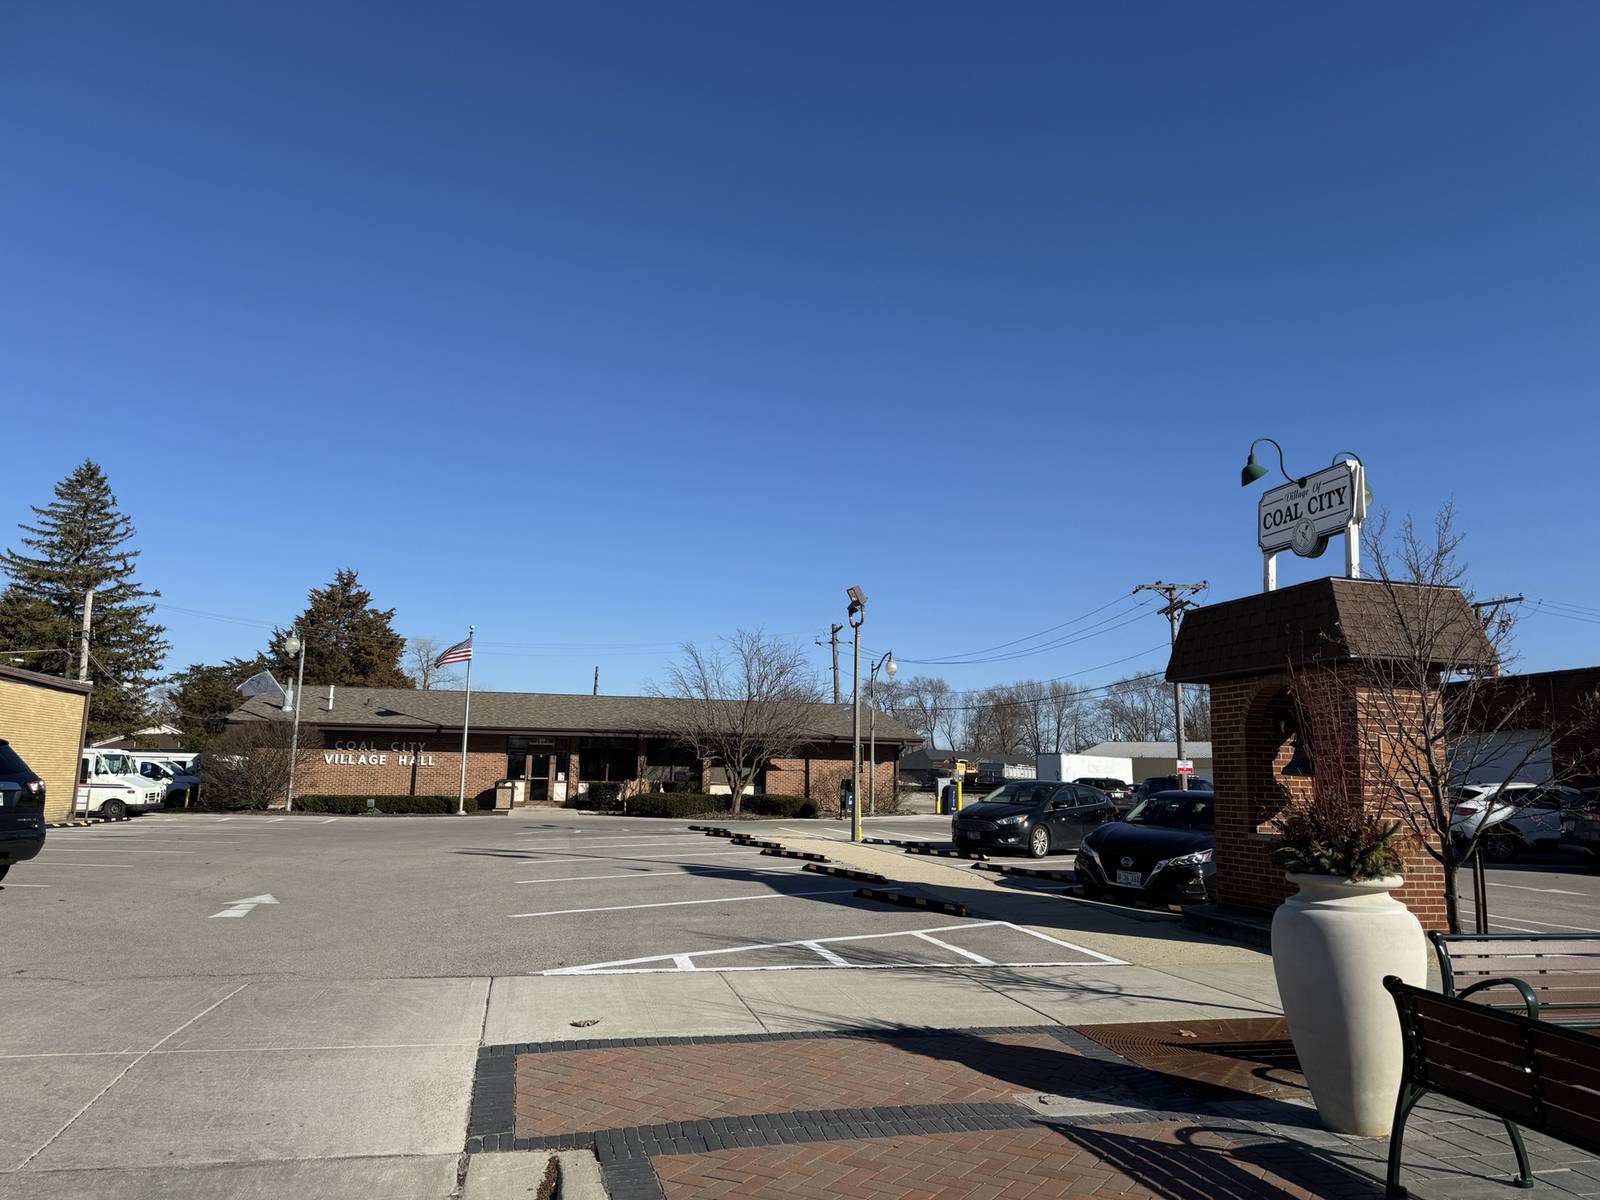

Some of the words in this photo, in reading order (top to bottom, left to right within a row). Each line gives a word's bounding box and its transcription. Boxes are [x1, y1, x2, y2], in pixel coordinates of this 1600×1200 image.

[1286, 488, 1309, 502] Village
[1263, 502, 1304, 530] COAL
[1307, 485, 1348, 515] CITY
[334, 740, 377, 751] COAL
[390, 741, 427, 753] CITY
[324, 753, 387, 765] VILLAGE
[398, 755, 435, 766] HALL
